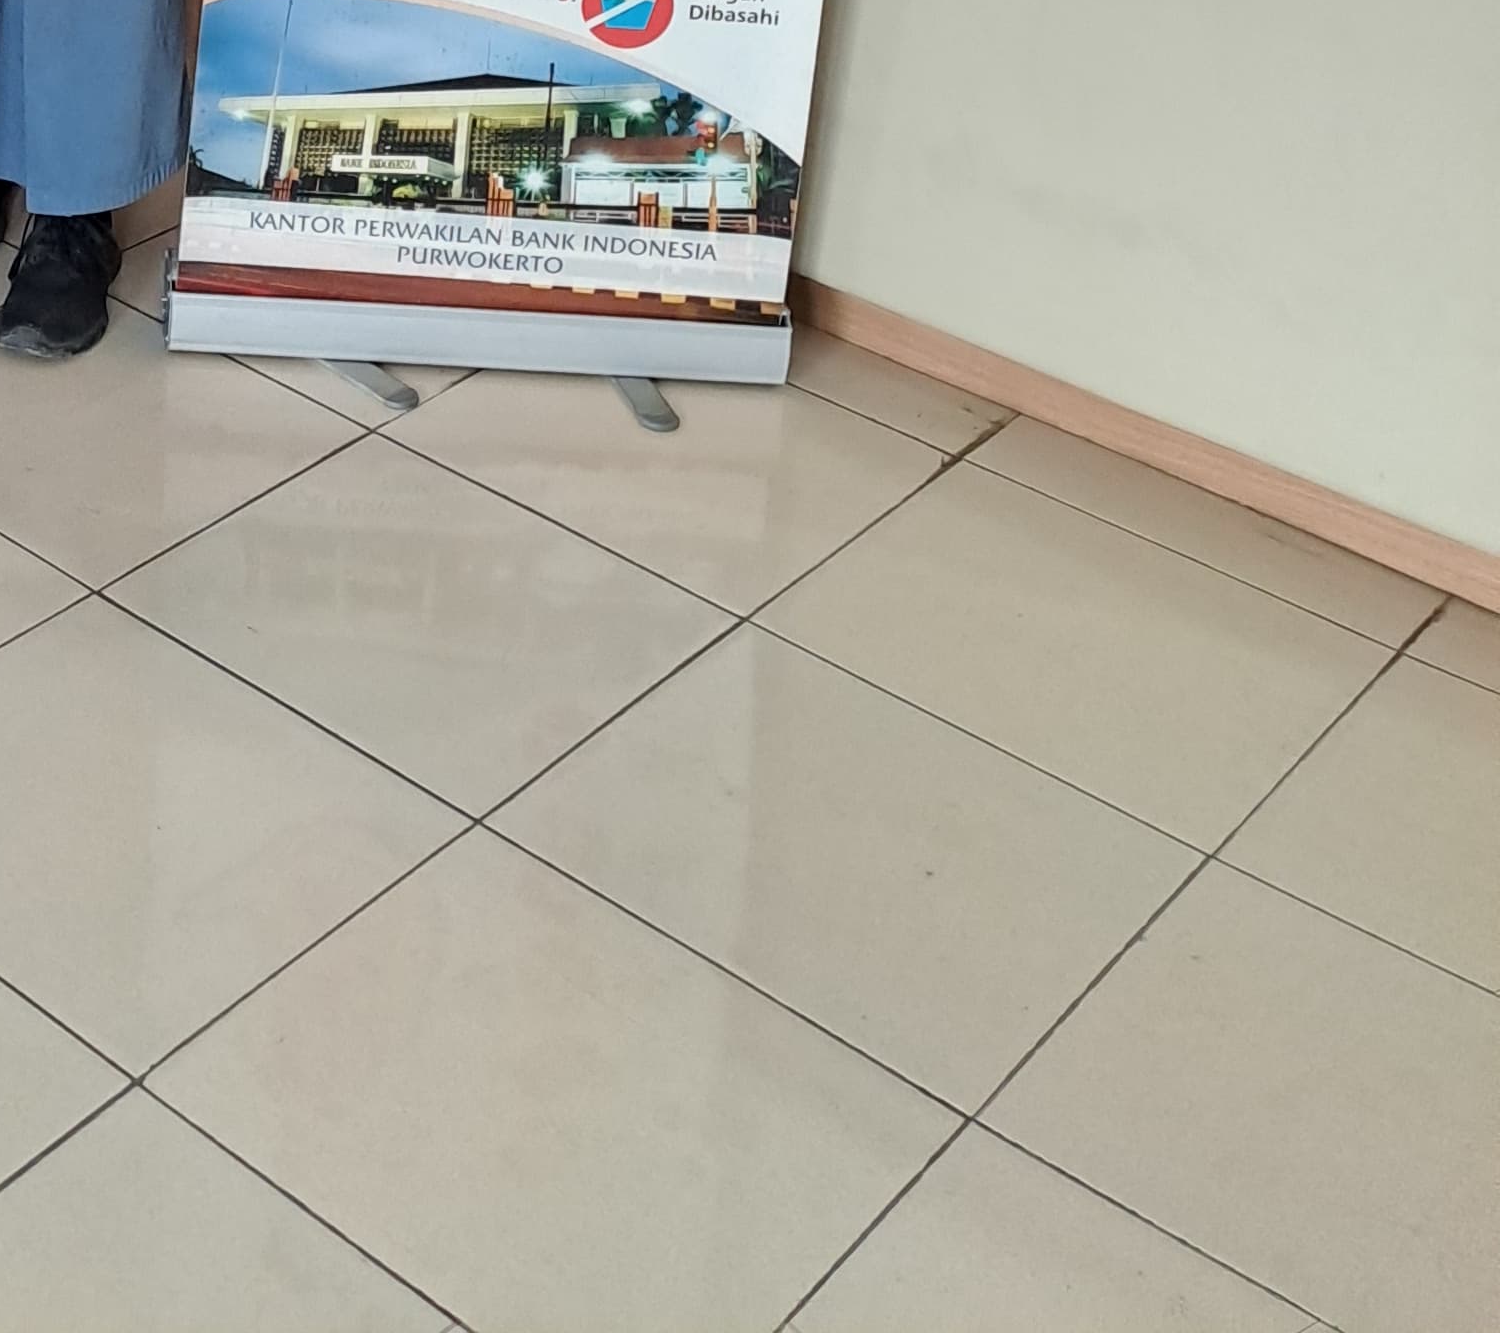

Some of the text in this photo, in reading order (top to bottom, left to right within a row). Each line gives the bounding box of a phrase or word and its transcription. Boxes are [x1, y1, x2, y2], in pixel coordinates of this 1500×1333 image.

[689, 4, 780, 25] Dibasahi
[249, 210, 717, 263] KANTOR PERWAKILAN BANK INDONESIA
[397, 245, 564, 275] PURWOKERTO
